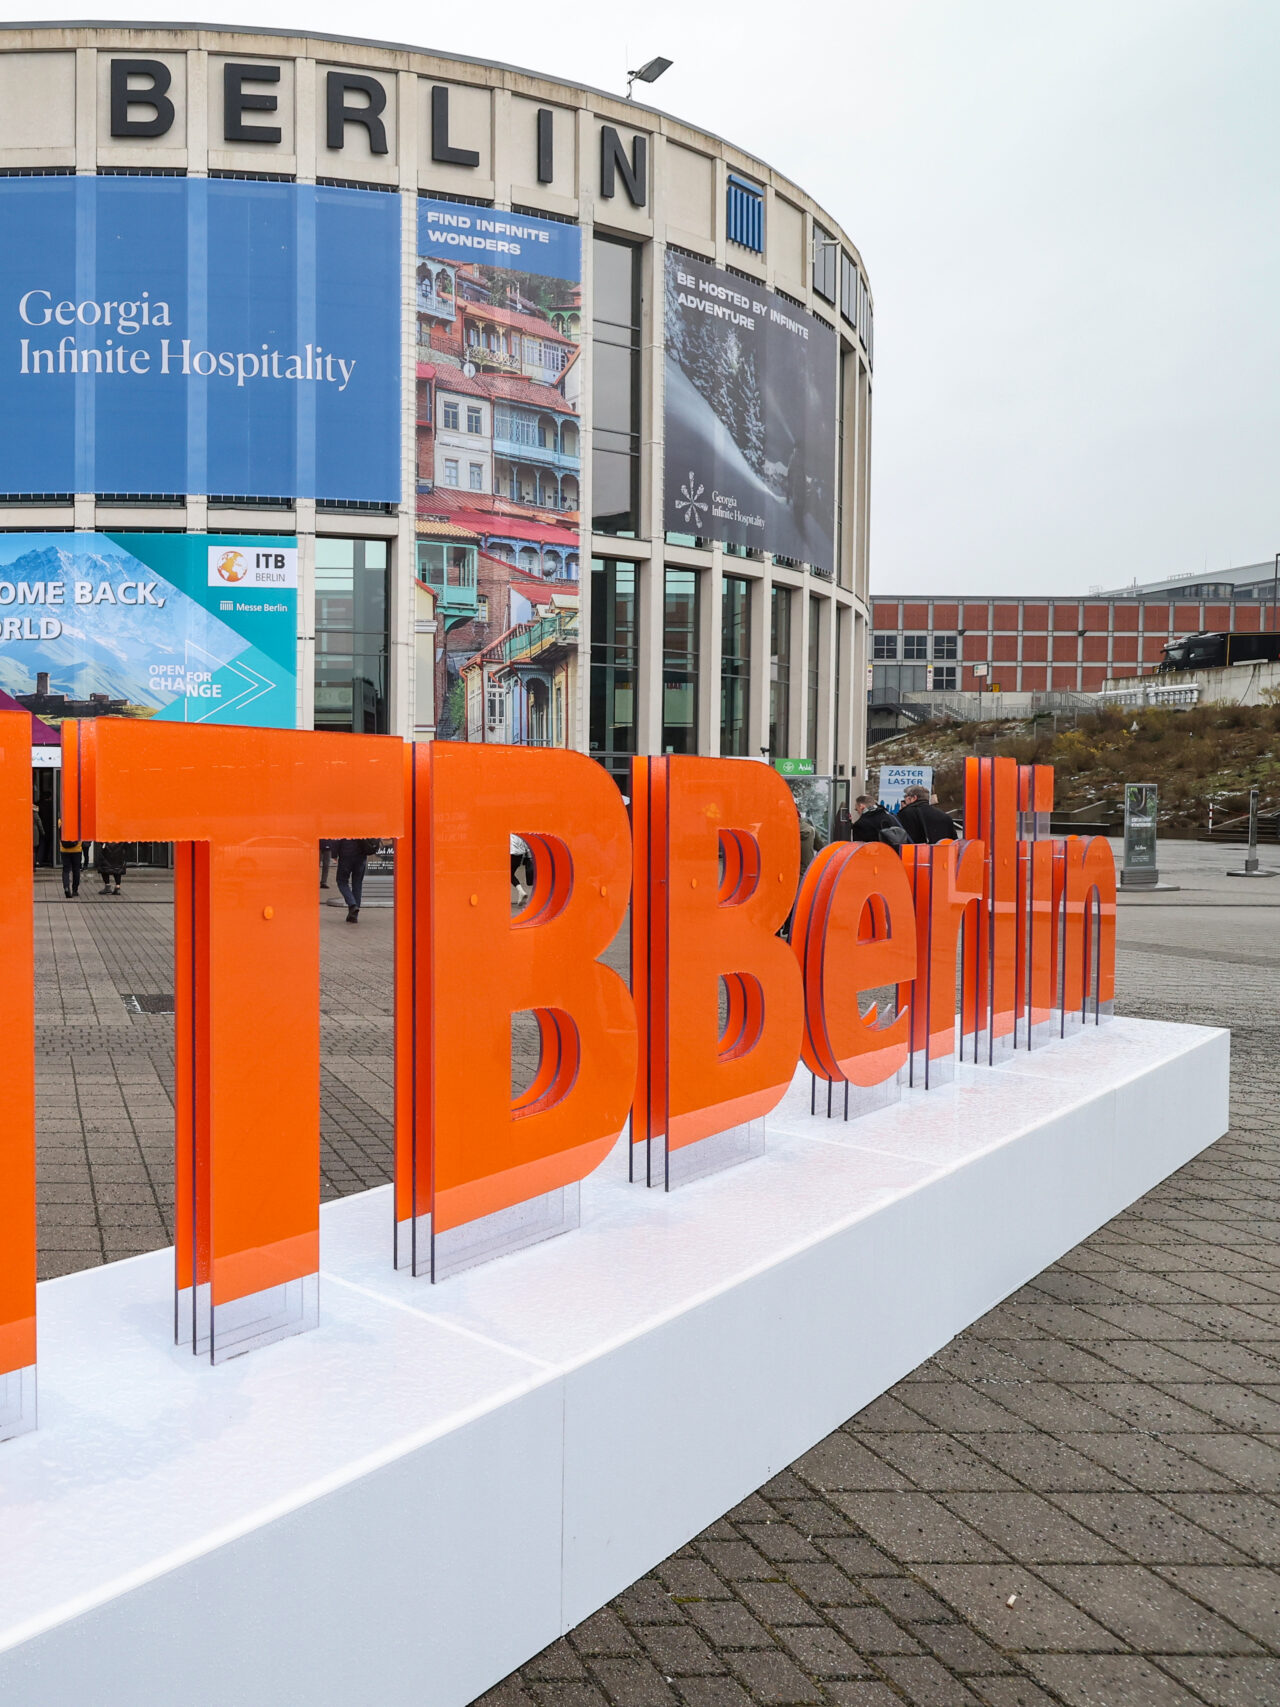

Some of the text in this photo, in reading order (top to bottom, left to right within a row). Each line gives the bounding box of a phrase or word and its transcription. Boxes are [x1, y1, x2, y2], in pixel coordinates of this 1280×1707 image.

[110, 58, 647, 208] BERLIN
[427, 211, 550, 244] FIND INFINITE
[428, 230, 521, 255] WONDERS
[18, 289, 173, 335] Georgia
[677, 271, 809, 340] BE HOSTED BY INFINITE
[677, 292, 755, 331] ADVENTURE
[20, 336, 357, 392] Infinite Hospitality
[712, 490, 738, 509] Georgia
[712, 504, 766, 530] Infinite Hospitality
[255, 553, 286, 569] ITB
[255, 573, 286, 583] BERLIN
[74, 580, 167, 608] BACK,
[236, 603, 288, 613] Messe Berlin
[148, 664, 212, 683] OPEN FOR
[148, 677, 222, 698] CHANGE
